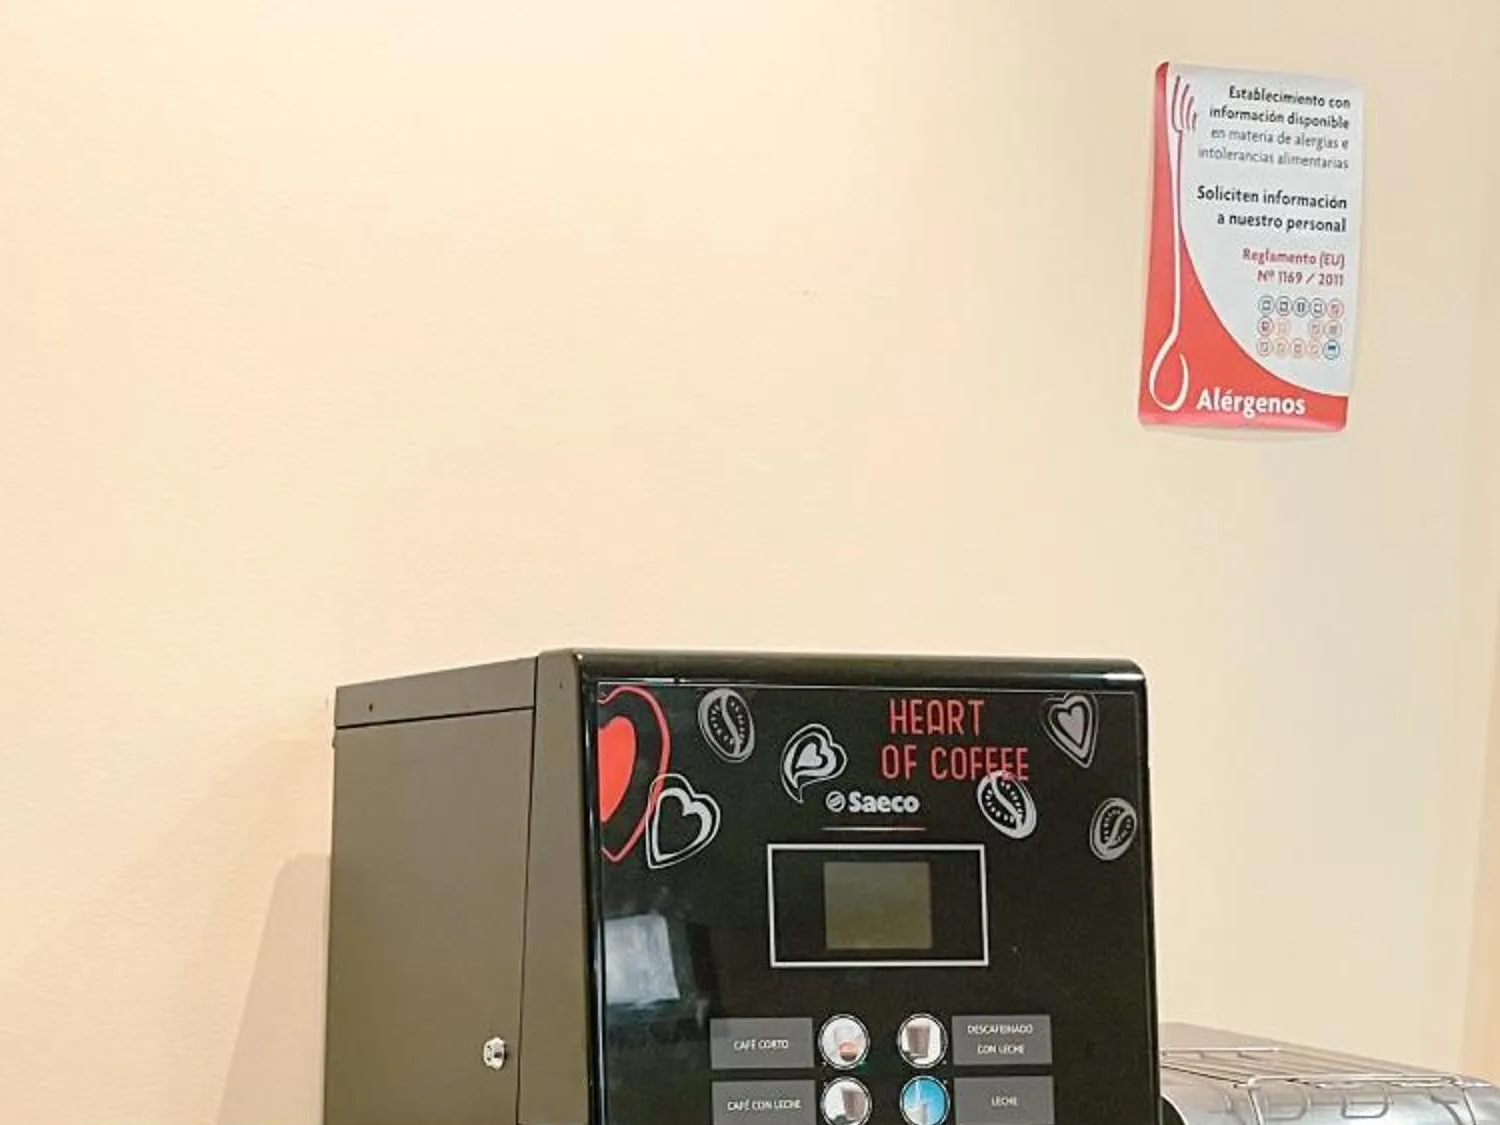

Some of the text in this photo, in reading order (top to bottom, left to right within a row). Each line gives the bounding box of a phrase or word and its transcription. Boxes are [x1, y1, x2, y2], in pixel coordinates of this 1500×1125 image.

[1229, 85, 1351, 109] Establecimiento con
[1209, 104, 1350, 130] información disponible
[1211, 129, 1226, 139] en
[1229, 128, 1274, 143] materia
[1276, 131, 1292, 145] de
[1293, 134, 1339, 152] alergias
[1197, 146, 1349, 169] intolerancias alimentarias
[1196, 184, 1348, 209] Soliciten información
[1217, 213, 1347, 233] a nuestro personal
[1242, 248, 1317, 266] Reglamento
[1279, 271, 1303, 285] 1169
[1317, 273, 1344, 287] 2011
[1196, 387, 1306, 419] Alérgenos
[889, 699, 985, 736] HEART
[881, 744, 1029, 781] OF COFFEE
[849, 791, 920, 813] Saeco
